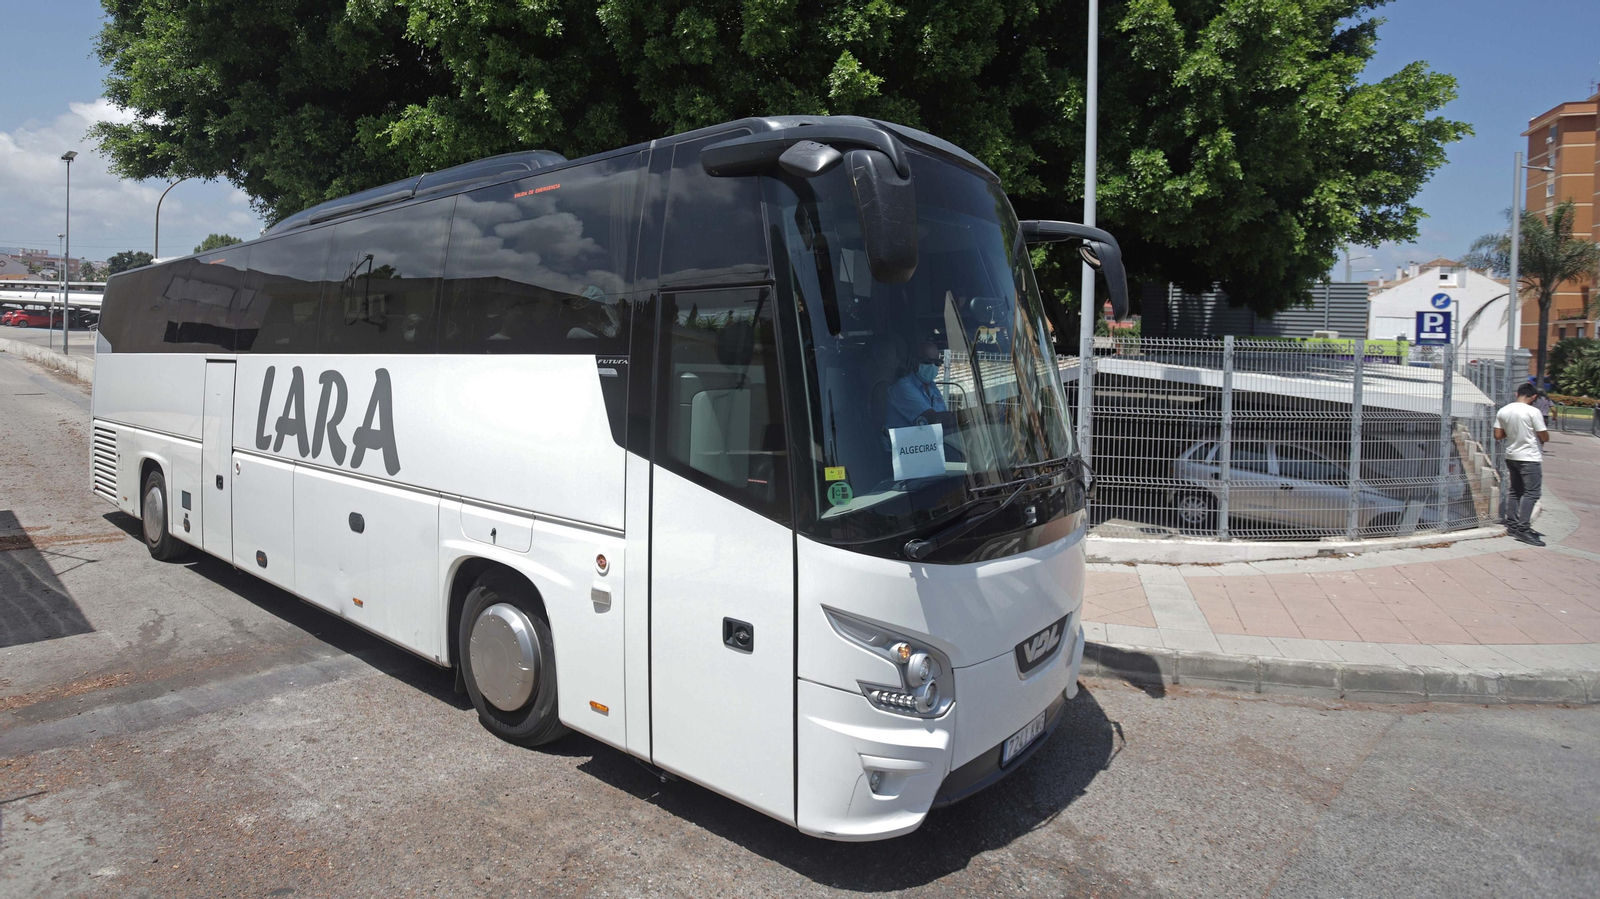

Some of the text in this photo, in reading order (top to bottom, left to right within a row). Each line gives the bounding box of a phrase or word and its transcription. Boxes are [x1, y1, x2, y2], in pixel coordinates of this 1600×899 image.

[1423, 313, 1444, 332] P
[255, 365, 401, 476] LARA
[900, 442, 937, 455] ALGECIRAS
[1023, 623, 1060, 663] VDL
